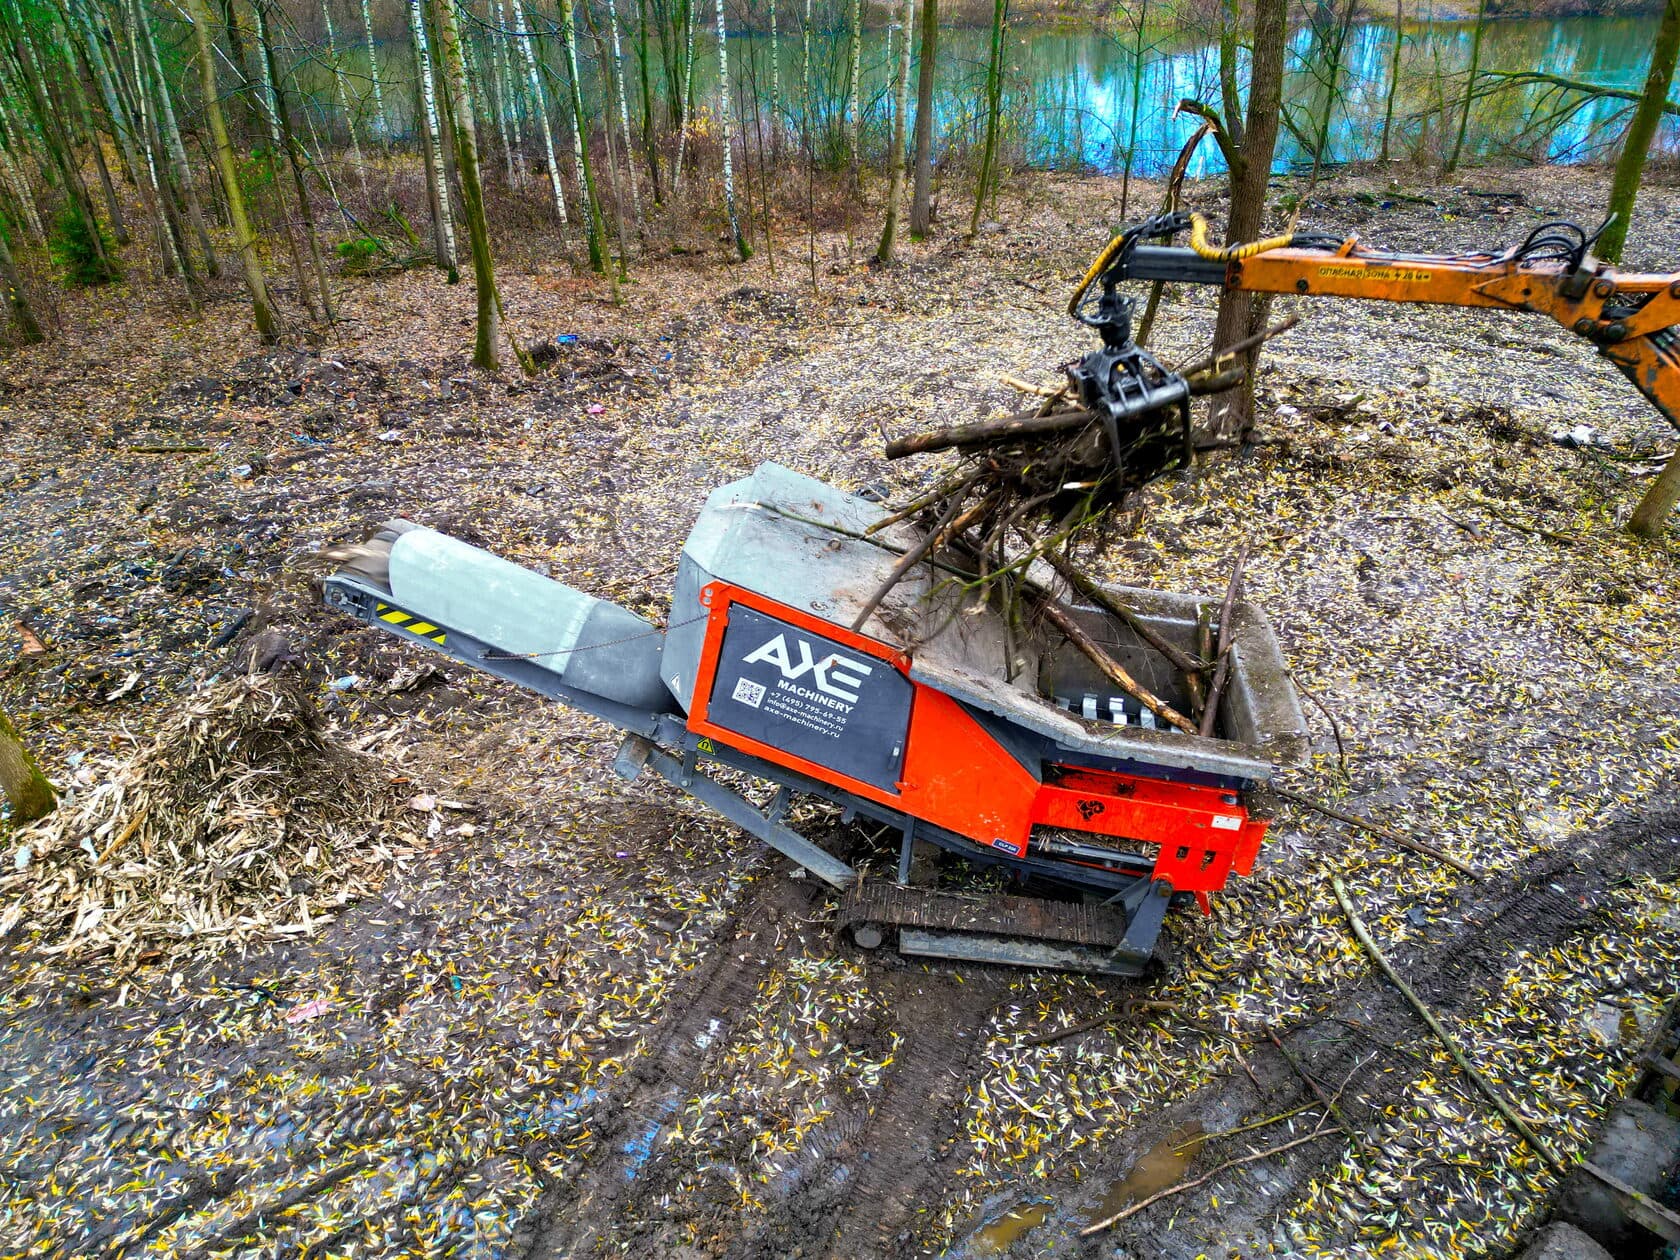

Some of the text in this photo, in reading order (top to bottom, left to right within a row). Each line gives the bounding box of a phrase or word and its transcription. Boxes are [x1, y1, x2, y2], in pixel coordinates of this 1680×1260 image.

[742, 633, 873, 704] AXE
[777, 679, 855, 714] MACHINERY
[782, 695, 804, 709] (495)
[763, 705, 840, 738] axe-machinery.ru
[767, 697, 844, 732] info@axe-machinery.ru
